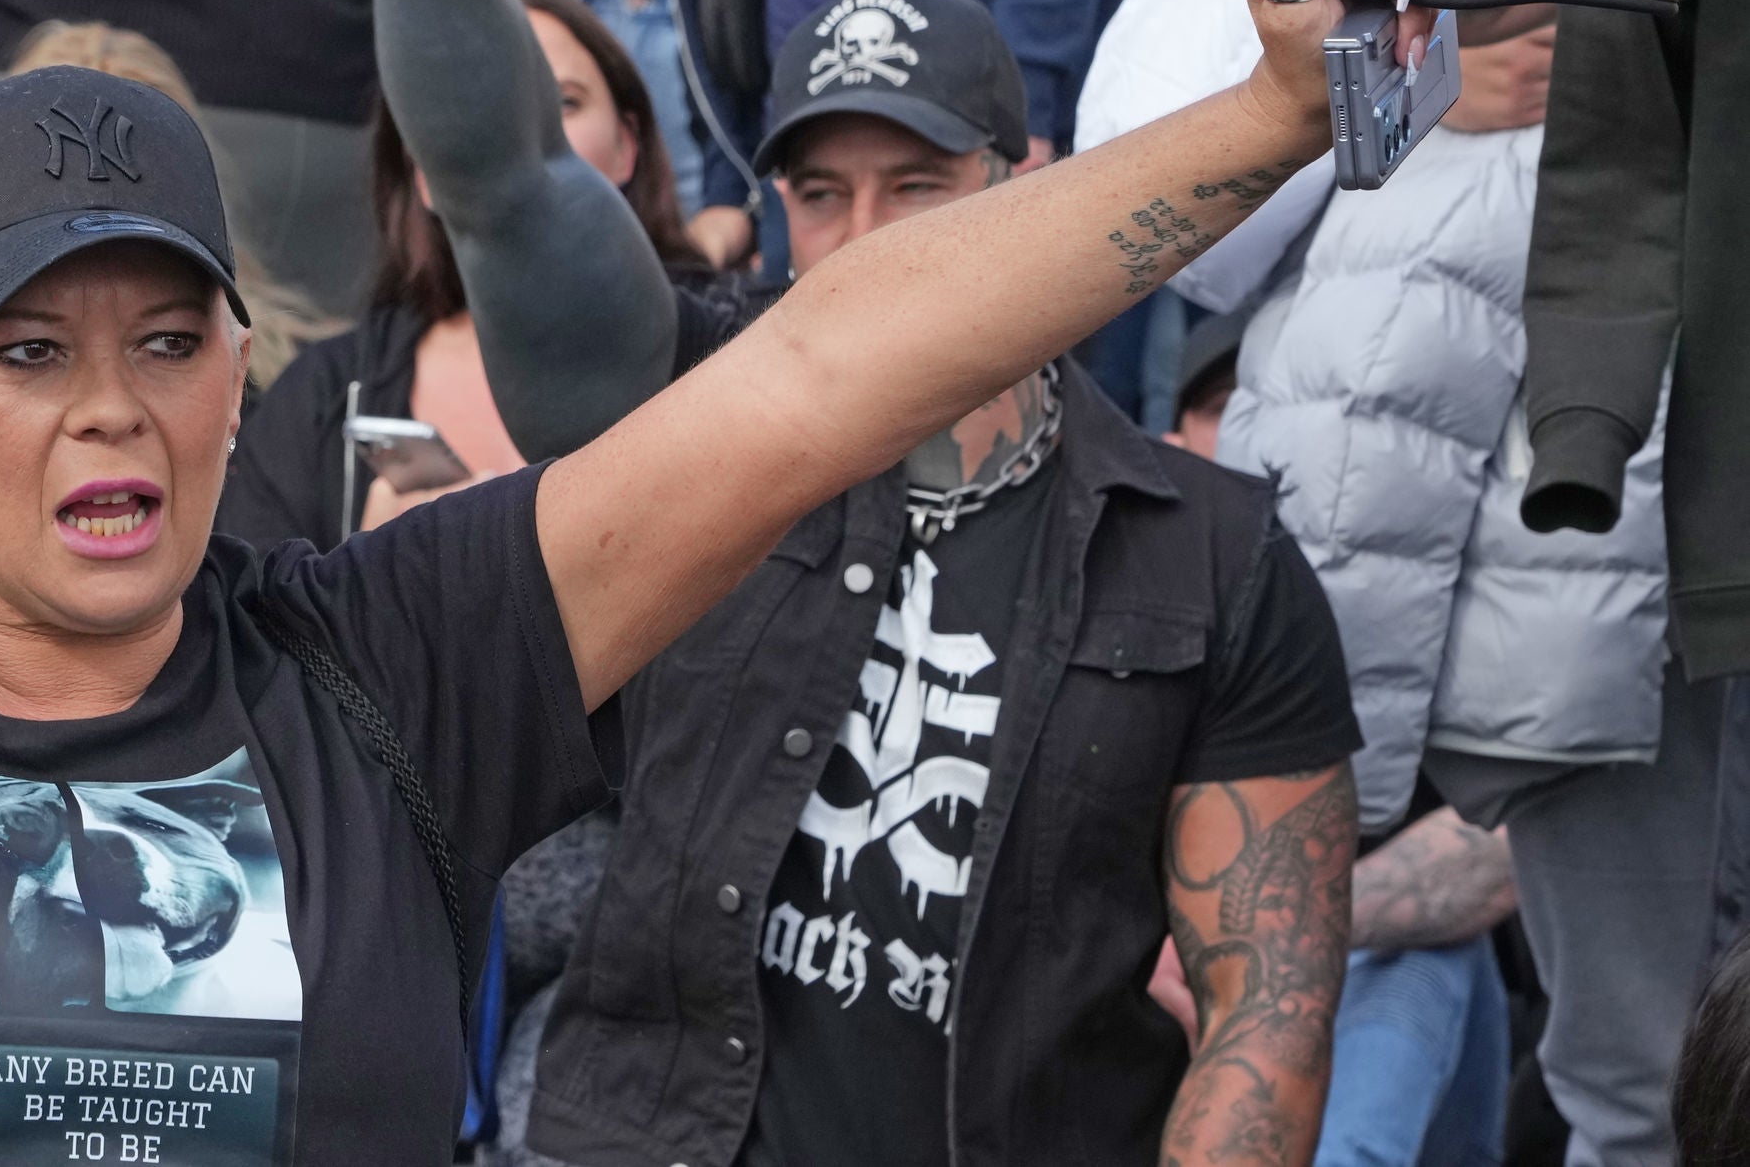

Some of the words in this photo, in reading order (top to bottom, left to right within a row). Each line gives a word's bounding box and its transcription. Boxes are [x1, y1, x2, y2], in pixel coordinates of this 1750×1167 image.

[34, 96, 143, 183] NY
[883, 938, 956, 1036] R
[65, 1058, 175, 1089] BREED
[188, 1064, 256, 1095] CAN
[24, 1094, 65, 1121] BE
[79, 1096, 212, 1129] TAUGHT
[65, 1131, 105, 1161] TO
[120, 1135, 161, 1163] BE
